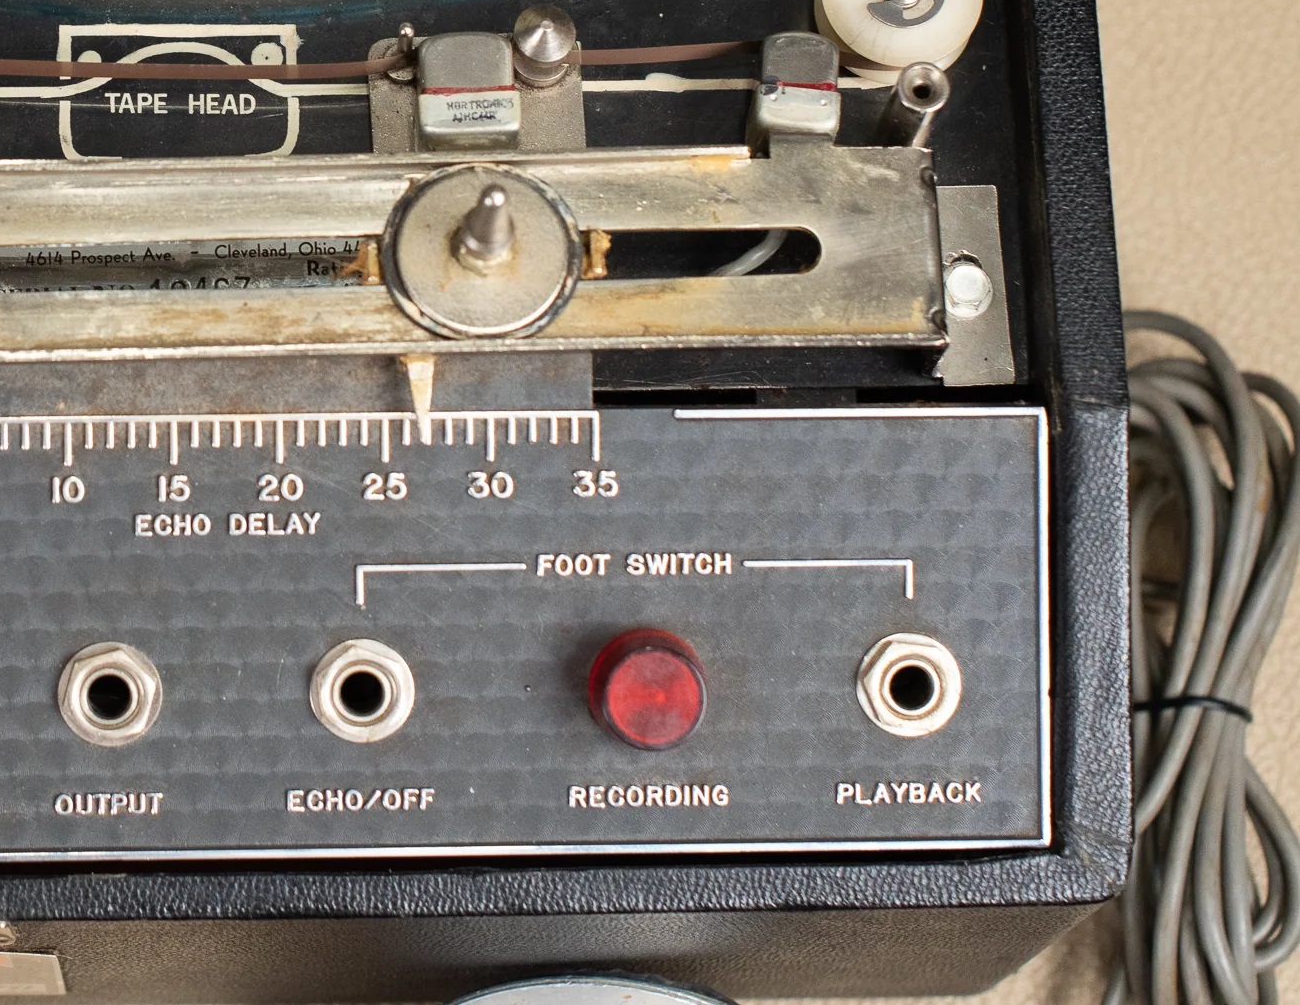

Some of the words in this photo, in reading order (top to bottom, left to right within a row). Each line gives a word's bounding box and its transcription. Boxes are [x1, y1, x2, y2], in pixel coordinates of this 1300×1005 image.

[104, 92, 168, 115] TAPE
[188, 93, 257, 115] HEAD
[26, 251, 64, 266] 4614
[71, 249, 136, 268] Prospect
[142, 246, 176, 262] Ave.
[214, 244, 293, 261] Cleveland,
[298, 240, 337, 256] Ohio
[51, 475, 86, 505] 10
[157, 474, 192, 503] 15
[257, 473, 305, 502] 20
[362, 472, 408, 501] 25
[467, 471, 515, 499] 30
[571, 470, 619, 498] 35
[134, 513, 212, 538] ECHO
[227, 511, 322, 537] DELAY
[536, 552, 611, 577] FOOT
[625, 552, 733, 576] SWITCH
[54, 792, 164, 816] OUTPUT
[287, 788, 436, 812] ECHO/OFF
[568, 784, 730, 809] RECORDING
[836, 781, 983, 805] PLAYBACK
